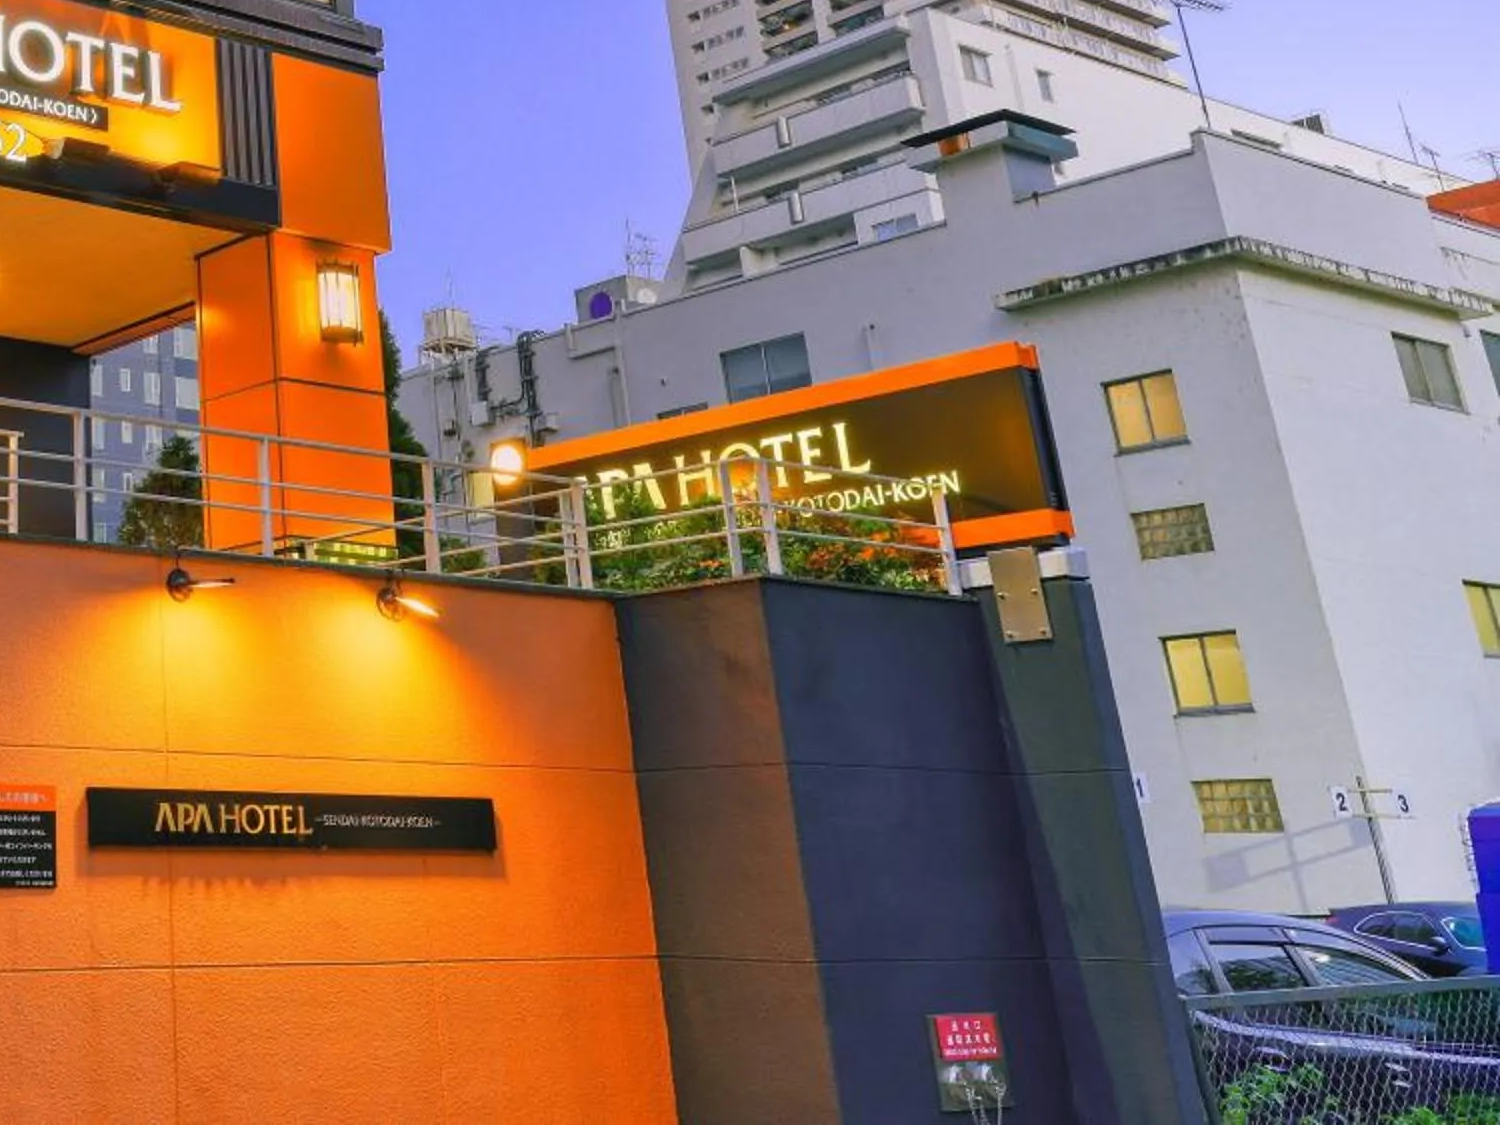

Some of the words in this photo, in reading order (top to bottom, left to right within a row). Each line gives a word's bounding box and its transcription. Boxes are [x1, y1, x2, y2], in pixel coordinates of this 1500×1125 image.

[576, 462, 667, 520] PA
[1336, 792, 1348, 811] 2
[1398, 794, 1409, 813] 3
[155, 802, 213, 833] APA
[219, 803, 313, 835] HOTEL
